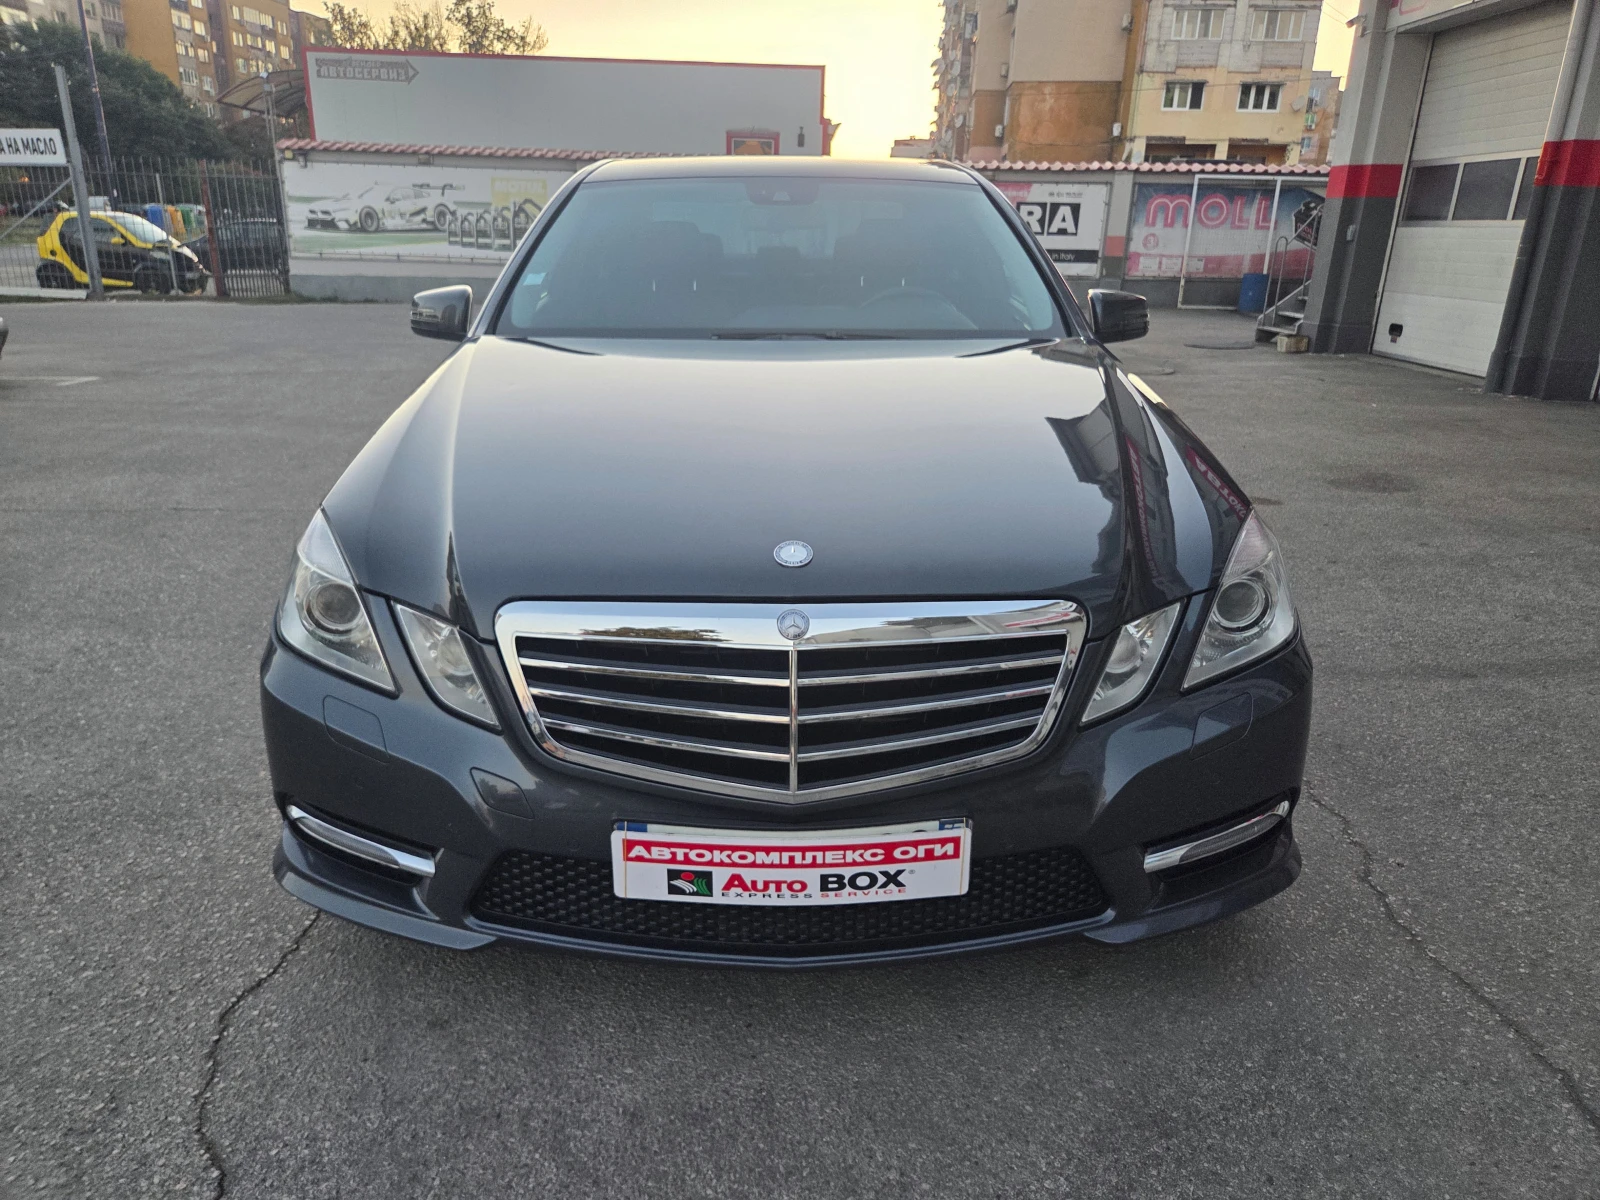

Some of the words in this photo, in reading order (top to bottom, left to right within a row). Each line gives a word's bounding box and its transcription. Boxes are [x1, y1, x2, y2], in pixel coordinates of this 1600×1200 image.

[320, 65, 406, 81] АВТОСЕРВИЗ
[5, 137, 21, 155] НА
[21, 137, 57, 155] МАСЛО
[1051, 252, 1059, 261] in
[628, 845, 886, 865] АВТОКОМПЛЕКС
[892, 842, 955, 860] ОГИ
[721, 891, 813, 899] EXPRESS
[820, 888, 907, 898] SERVICE
